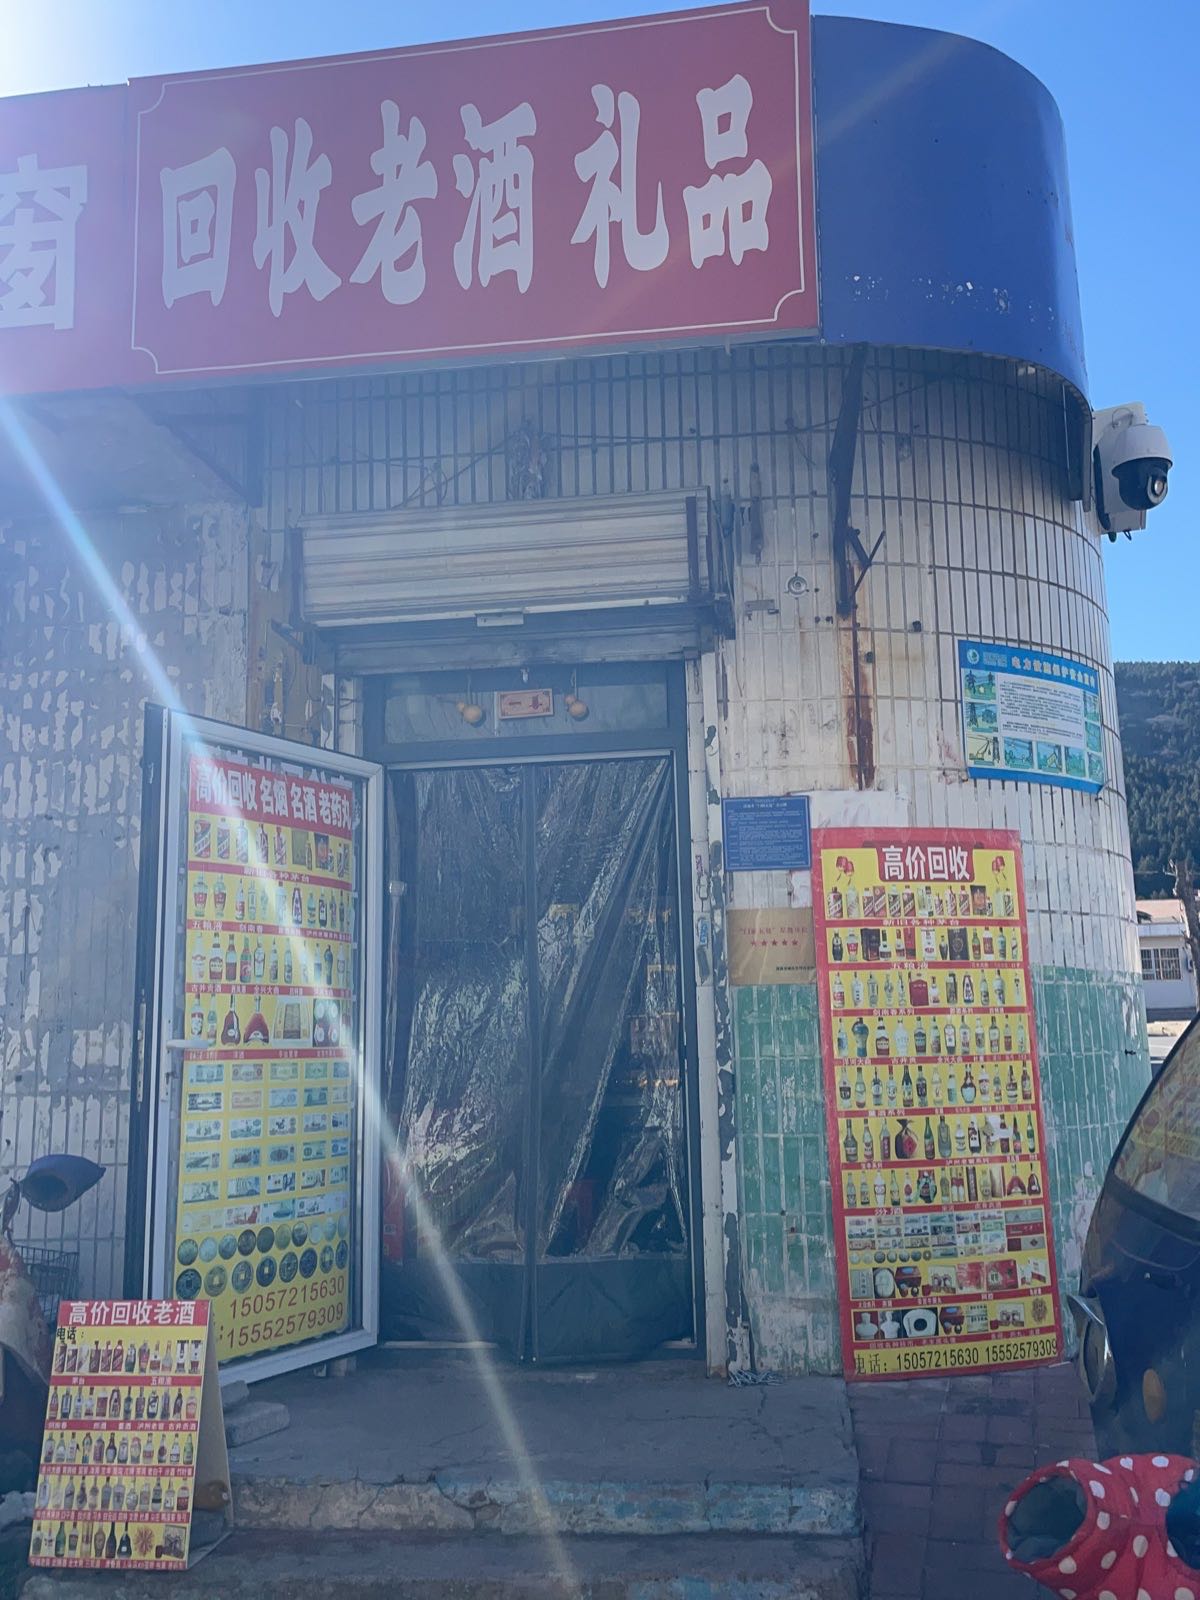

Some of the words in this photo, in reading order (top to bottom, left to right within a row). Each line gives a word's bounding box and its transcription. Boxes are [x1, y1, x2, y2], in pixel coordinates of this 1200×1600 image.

[159, 99, 538, 317] 回收老酒
[570, 74, 772, 288] 礼品
[196, 762, 258, 812] 高价回收
[882, 845, 970, 881] 高价回收
[191, 921, 223, 931] 五粮液
[69, 1301, 196, 1325] 高价回收老酒
[229, 1275, 345, 1320] 15057215630
[896, 1347, 979, 1371] 15057215630
[985, 1338, 1058, 1362] 15552579309
[151, 1376, 172, 1386] 五粮液
[137, 1421, 165, 1431] 泸州老窖
